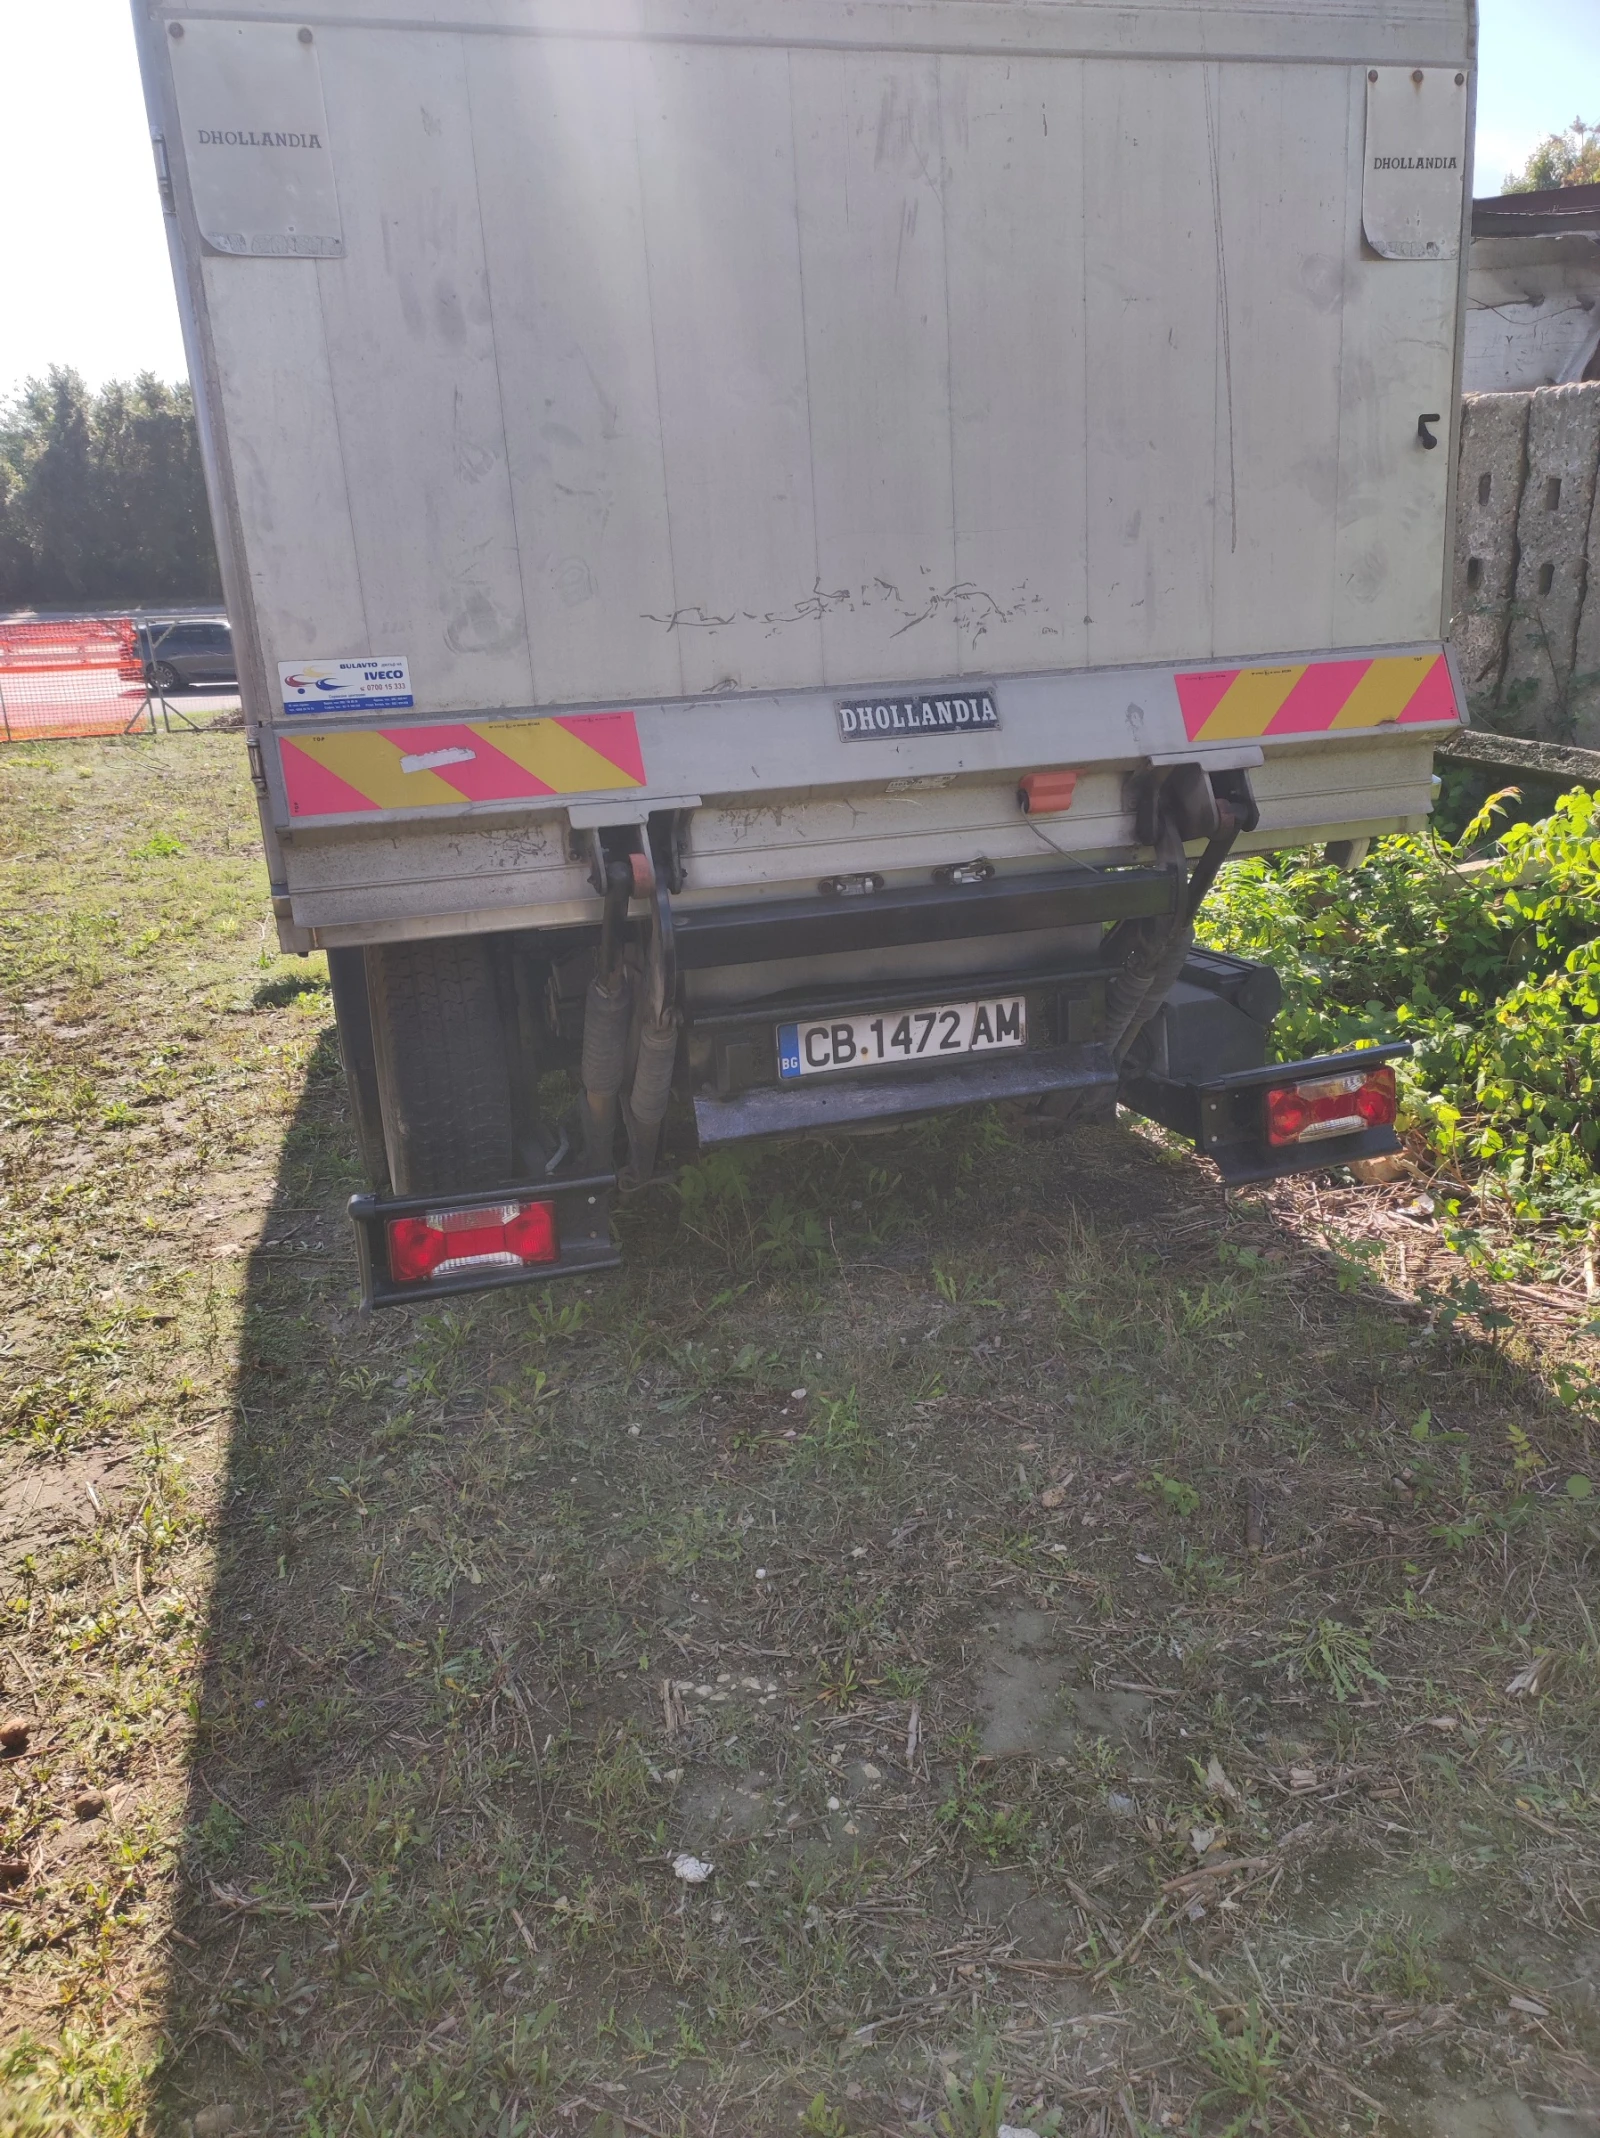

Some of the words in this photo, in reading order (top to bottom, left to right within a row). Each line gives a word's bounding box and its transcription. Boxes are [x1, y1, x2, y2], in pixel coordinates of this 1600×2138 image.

[197, 129, 322, 149] DHOLLANDIA
[1373, 156, 1458, 170] DHOLLANDIA
[364, 670, 404, 681] IVECO
[839, 698, 998, 732] DHOLLANDIA
[870, 1010, 961, 1059] 1472
[971, 1002, 1020, 1046] AM
[782, 1057, 798, 1070] BG
